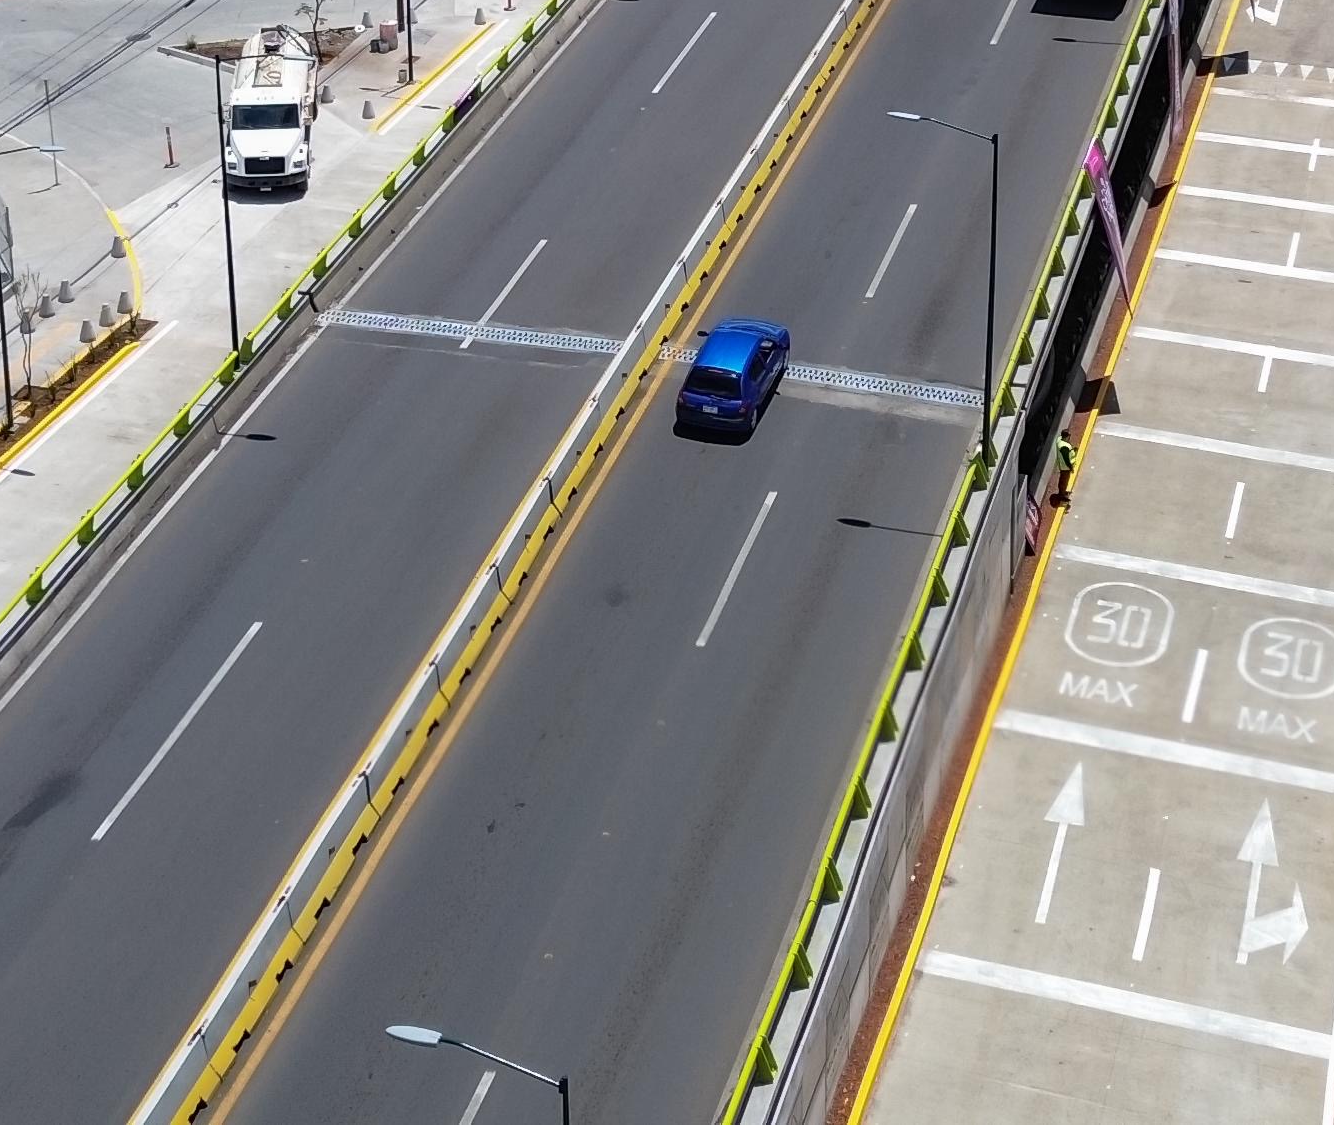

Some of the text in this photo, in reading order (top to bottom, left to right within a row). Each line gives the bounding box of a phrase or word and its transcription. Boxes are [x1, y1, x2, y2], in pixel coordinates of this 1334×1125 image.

[1085, 599, 1153, 649] 30
[1259, 631, 1325, 684] 30
[1057, 671, 1139, 709] MAX
[1236, 705, 1318, 745] MAX
